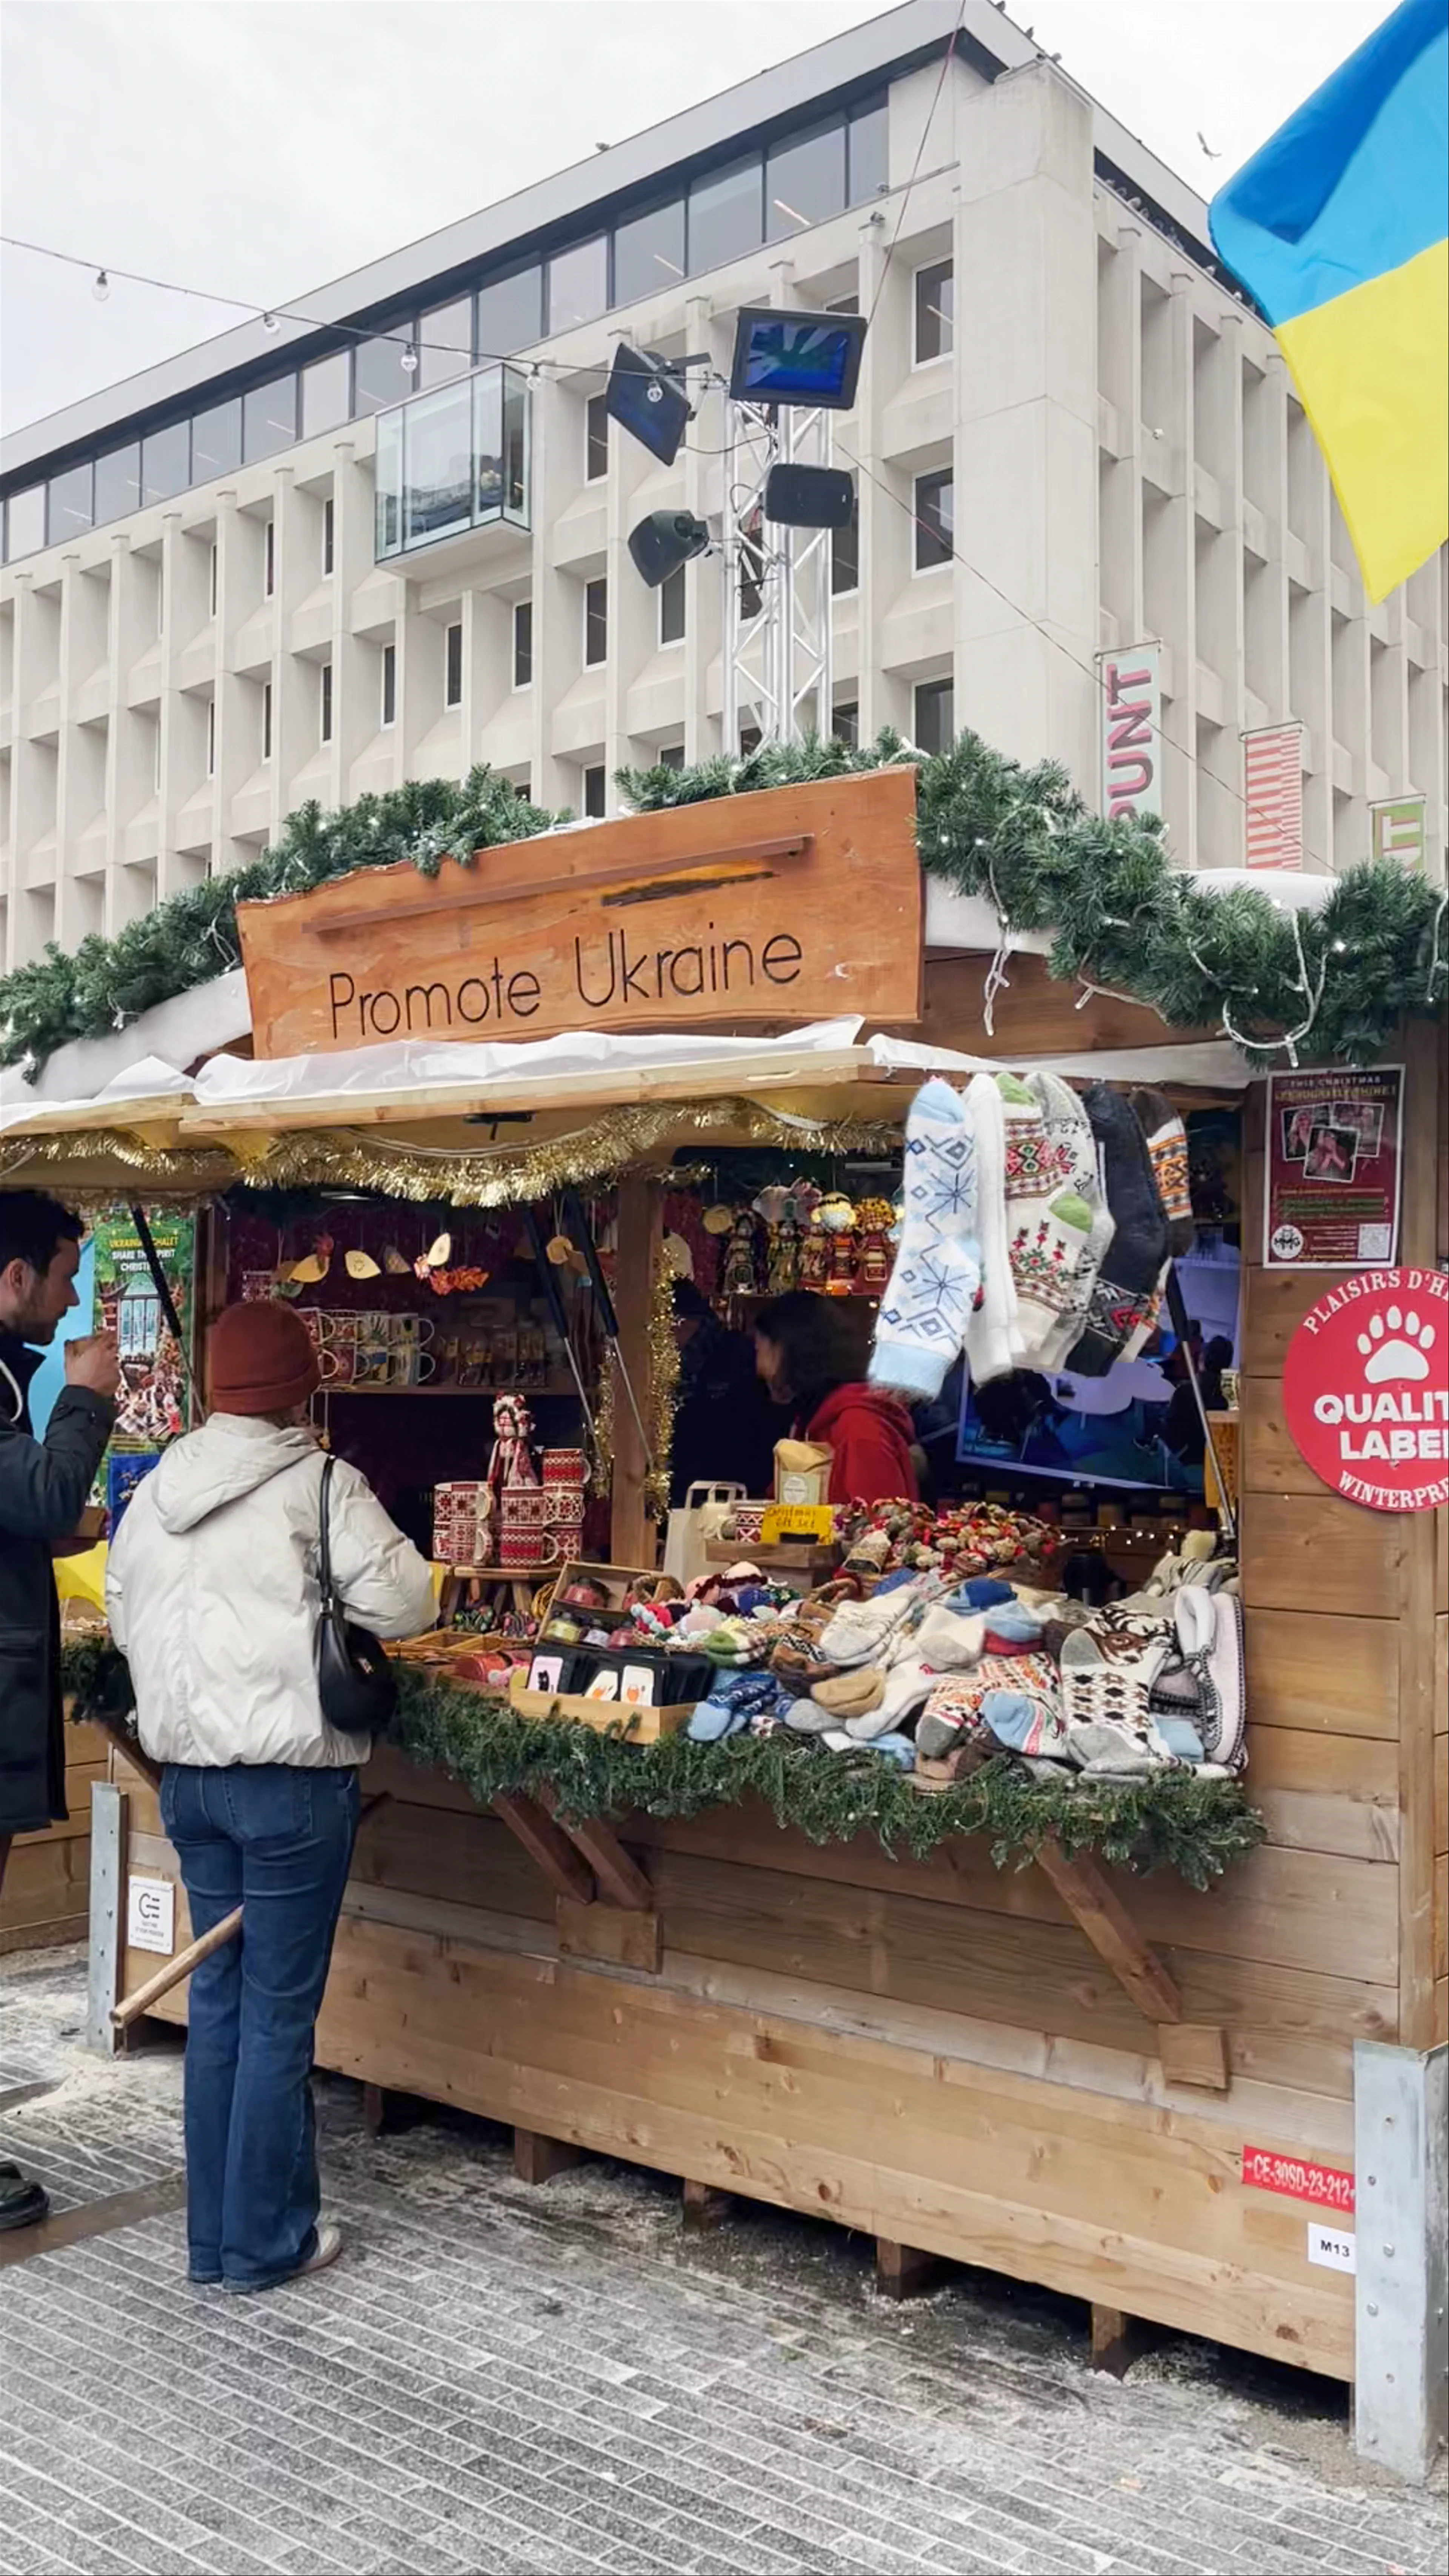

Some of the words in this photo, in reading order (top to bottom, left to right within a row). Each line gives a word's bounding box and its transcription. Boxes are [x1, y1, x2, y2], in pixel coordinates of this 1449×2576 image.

[329, 958, 541, 1040] Promote
[575, 922, 803, 1007] Ukraine
[1303, 1269, 1401, 1335] PLAISIRS
[1320, 2239, 1350, 2258] M13
